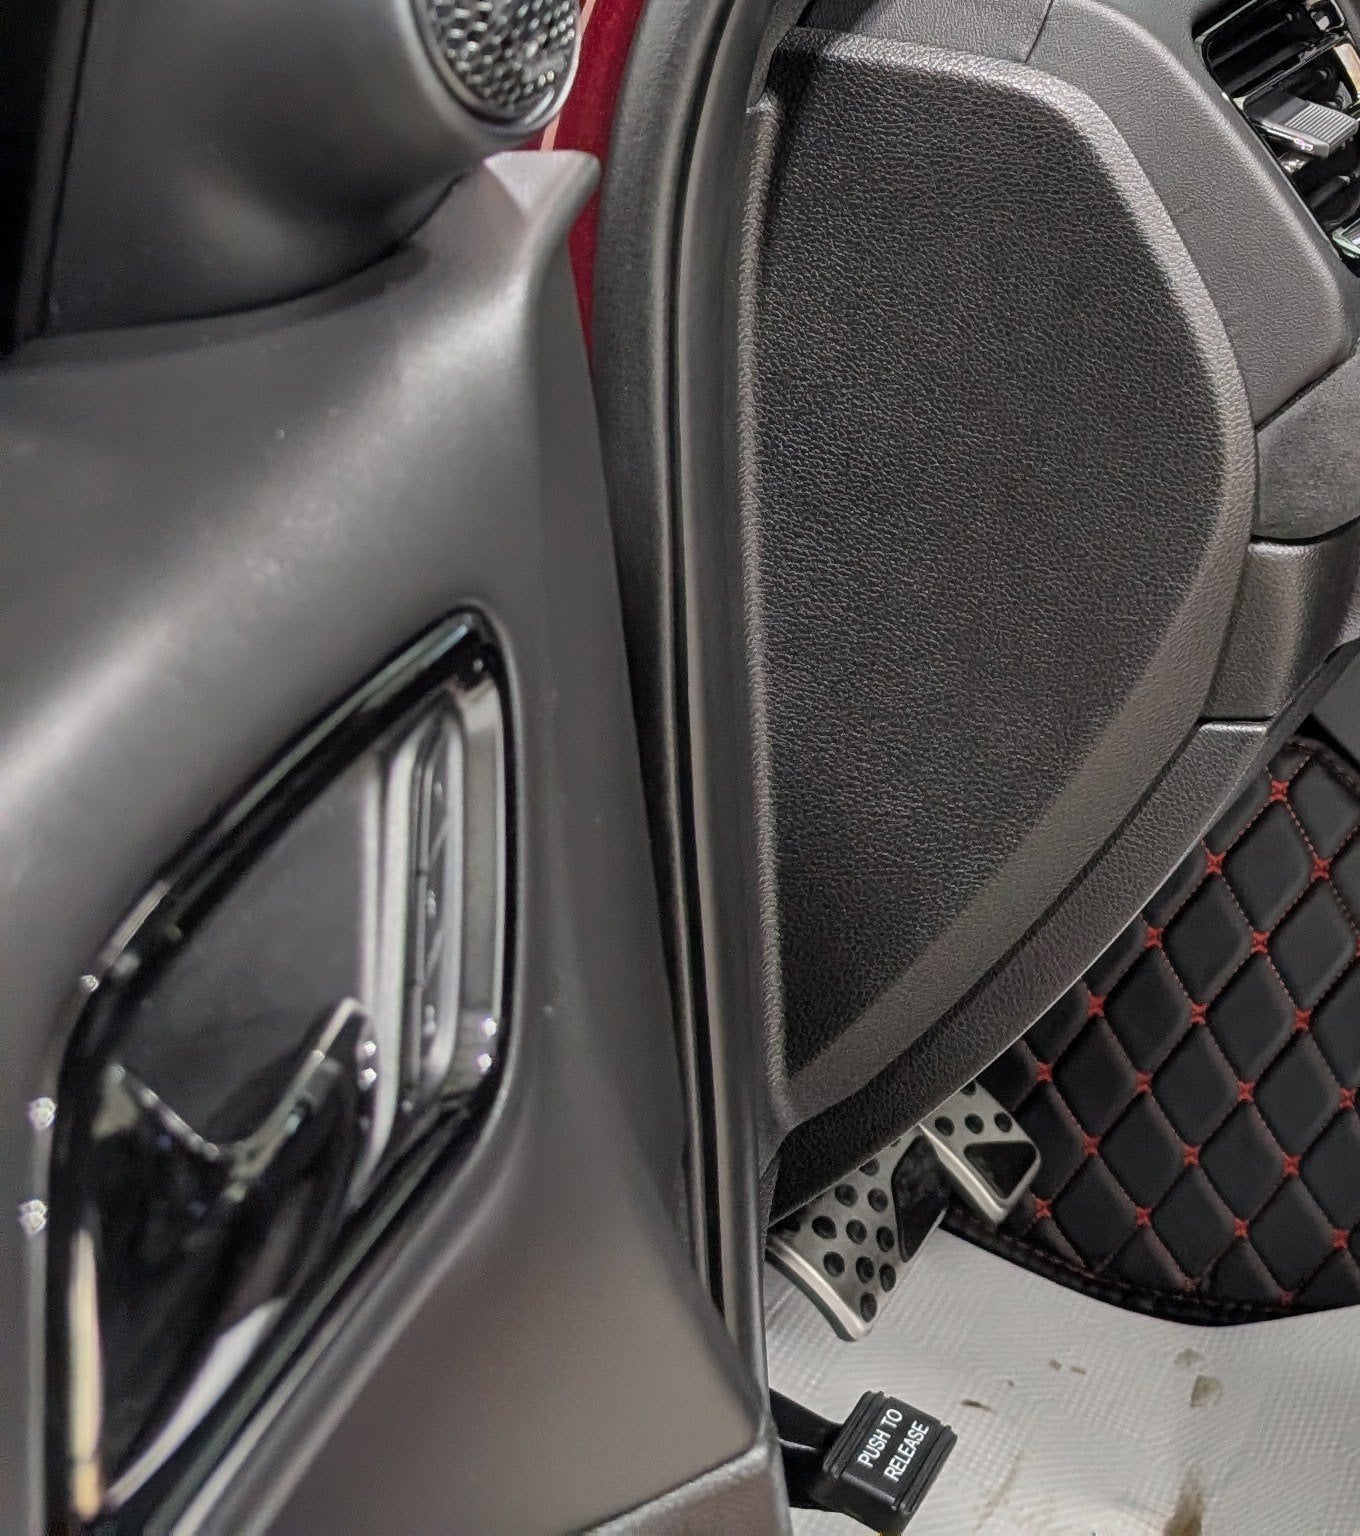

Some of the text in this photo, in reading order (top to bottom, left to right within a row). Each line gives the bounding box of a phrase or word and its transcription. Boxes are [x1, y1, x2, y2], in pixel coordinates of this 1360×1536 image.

[857, 1408, 903, 1468] PUSH TO
[883, 1421, 930, 1483] RELEASE
